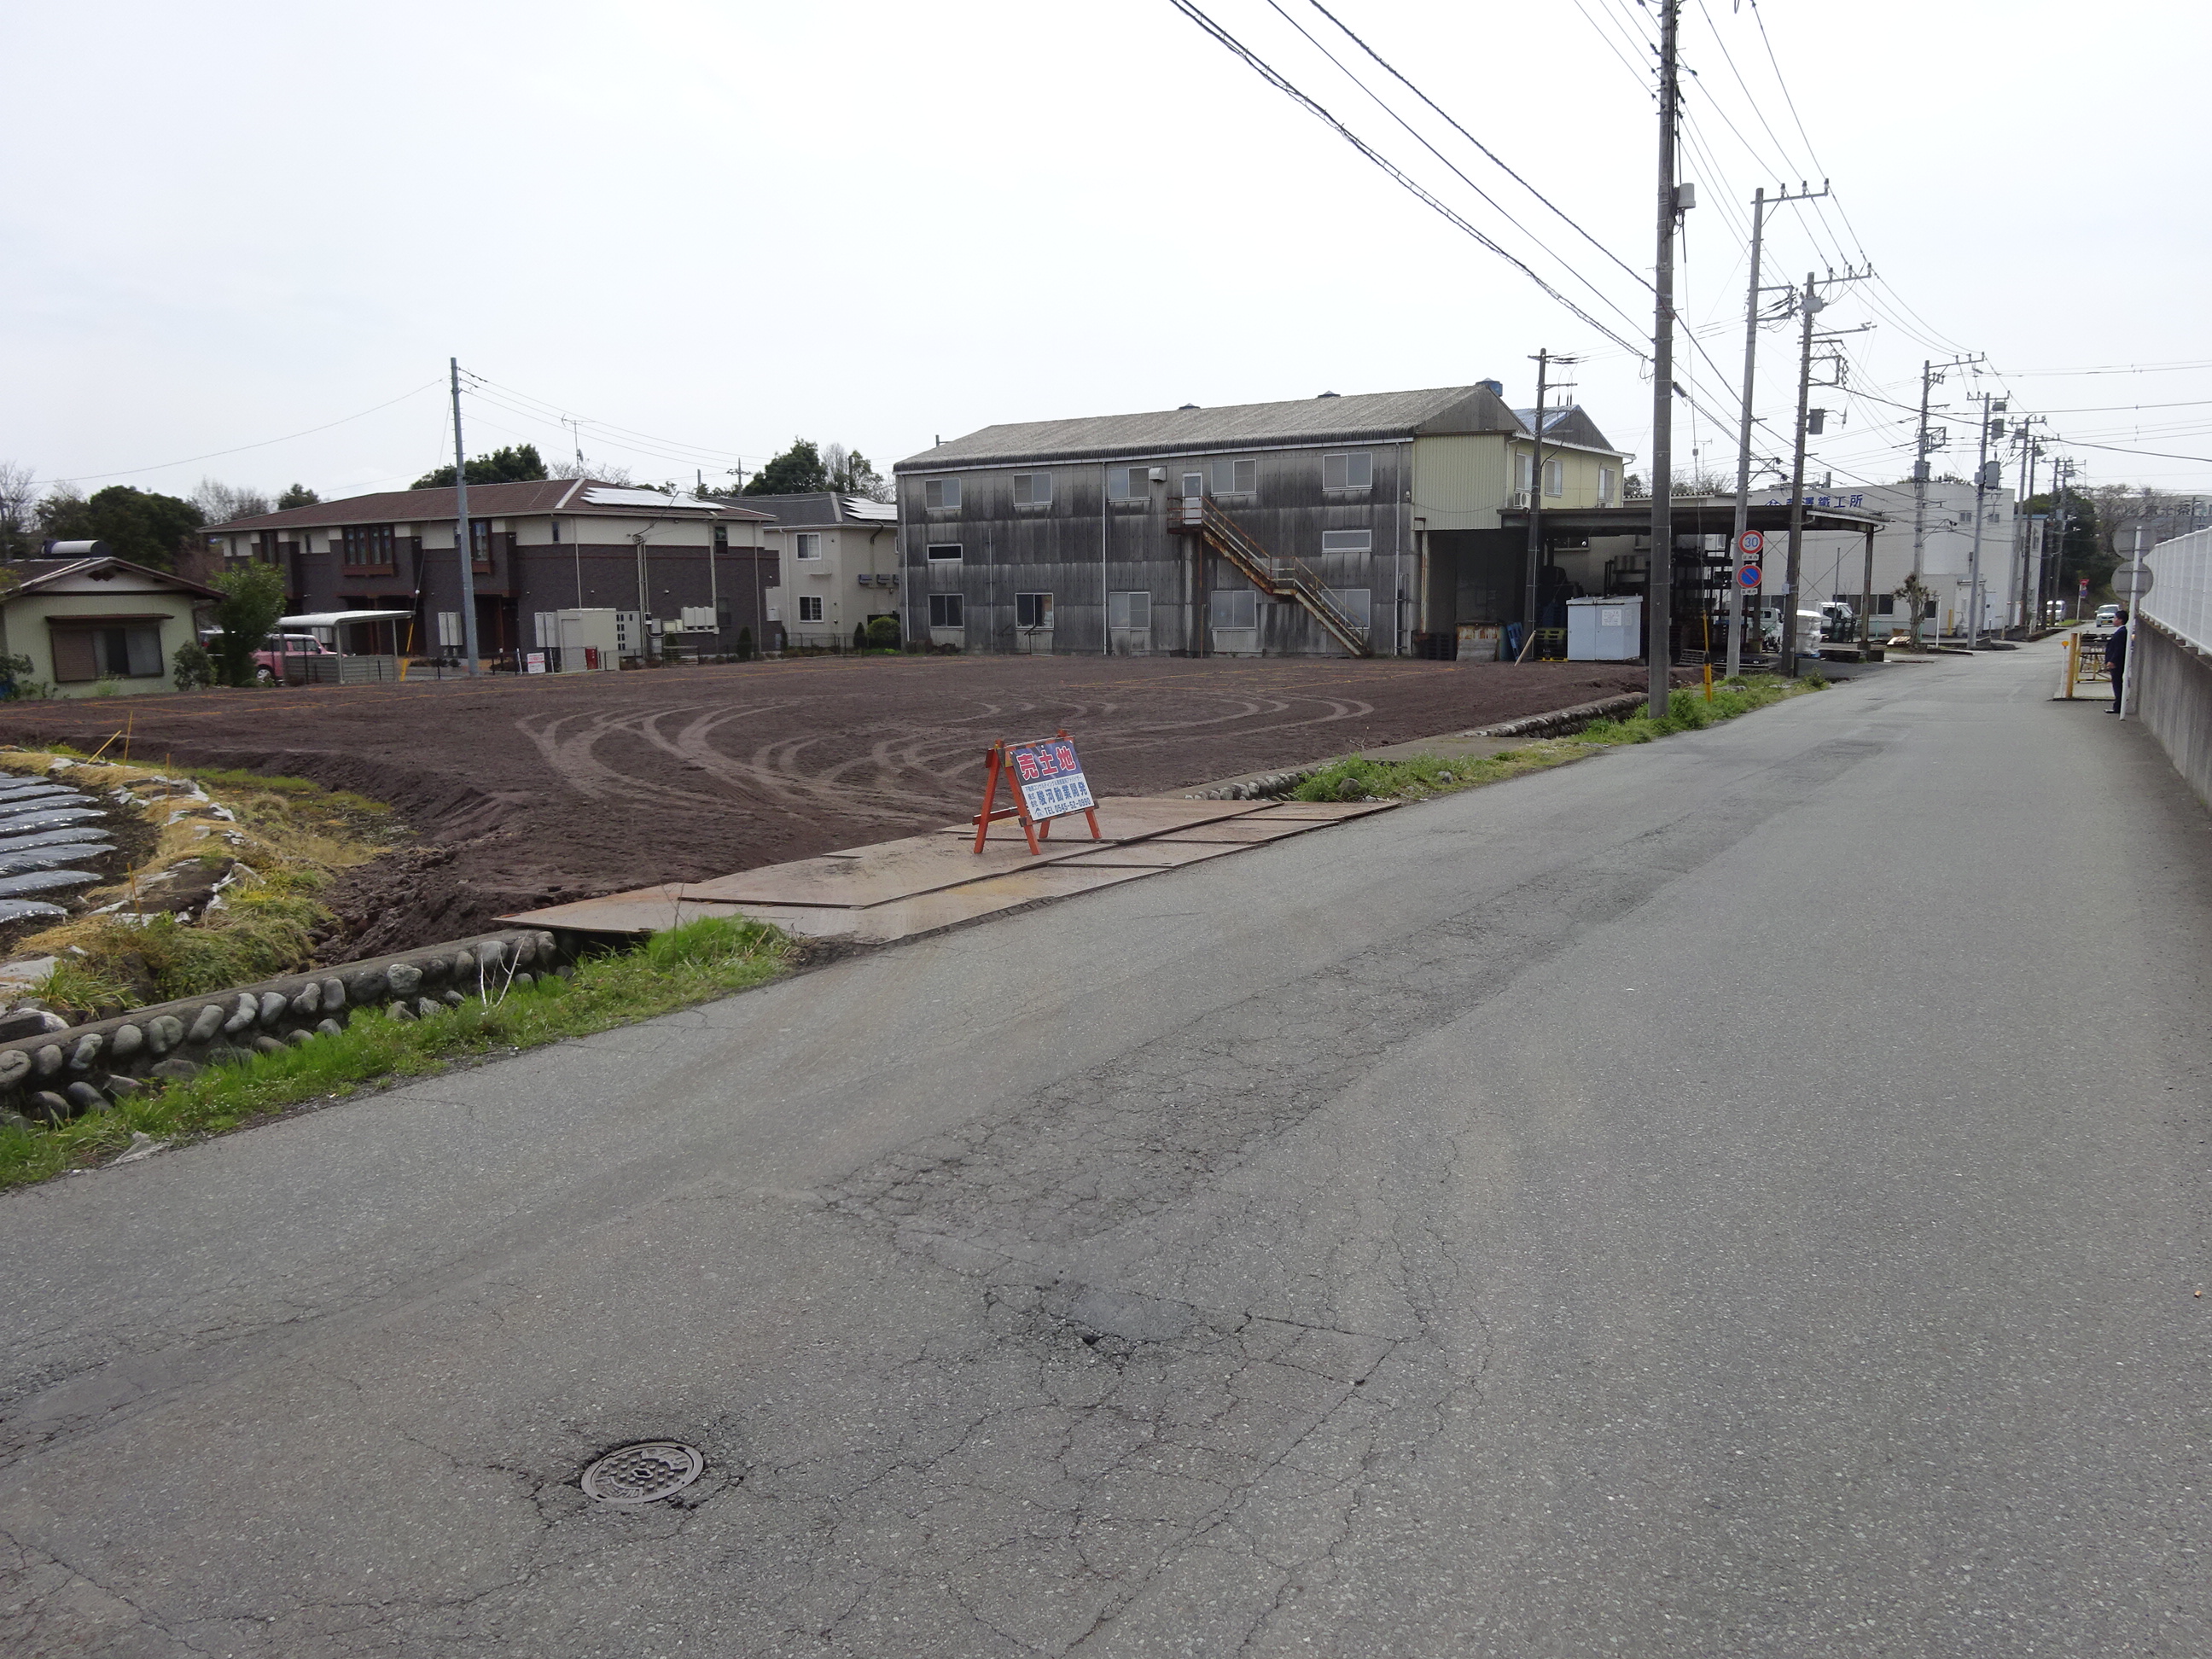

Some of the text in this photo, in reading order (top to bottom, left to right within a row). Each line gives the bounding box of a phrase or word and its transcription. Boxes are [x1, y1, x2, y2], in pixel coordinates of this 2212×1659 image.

[1744, 537, 1759, 548] 30
[1016, 746, 1076, 781] 売土地
[1044, 806, 1055, 815] TEL
